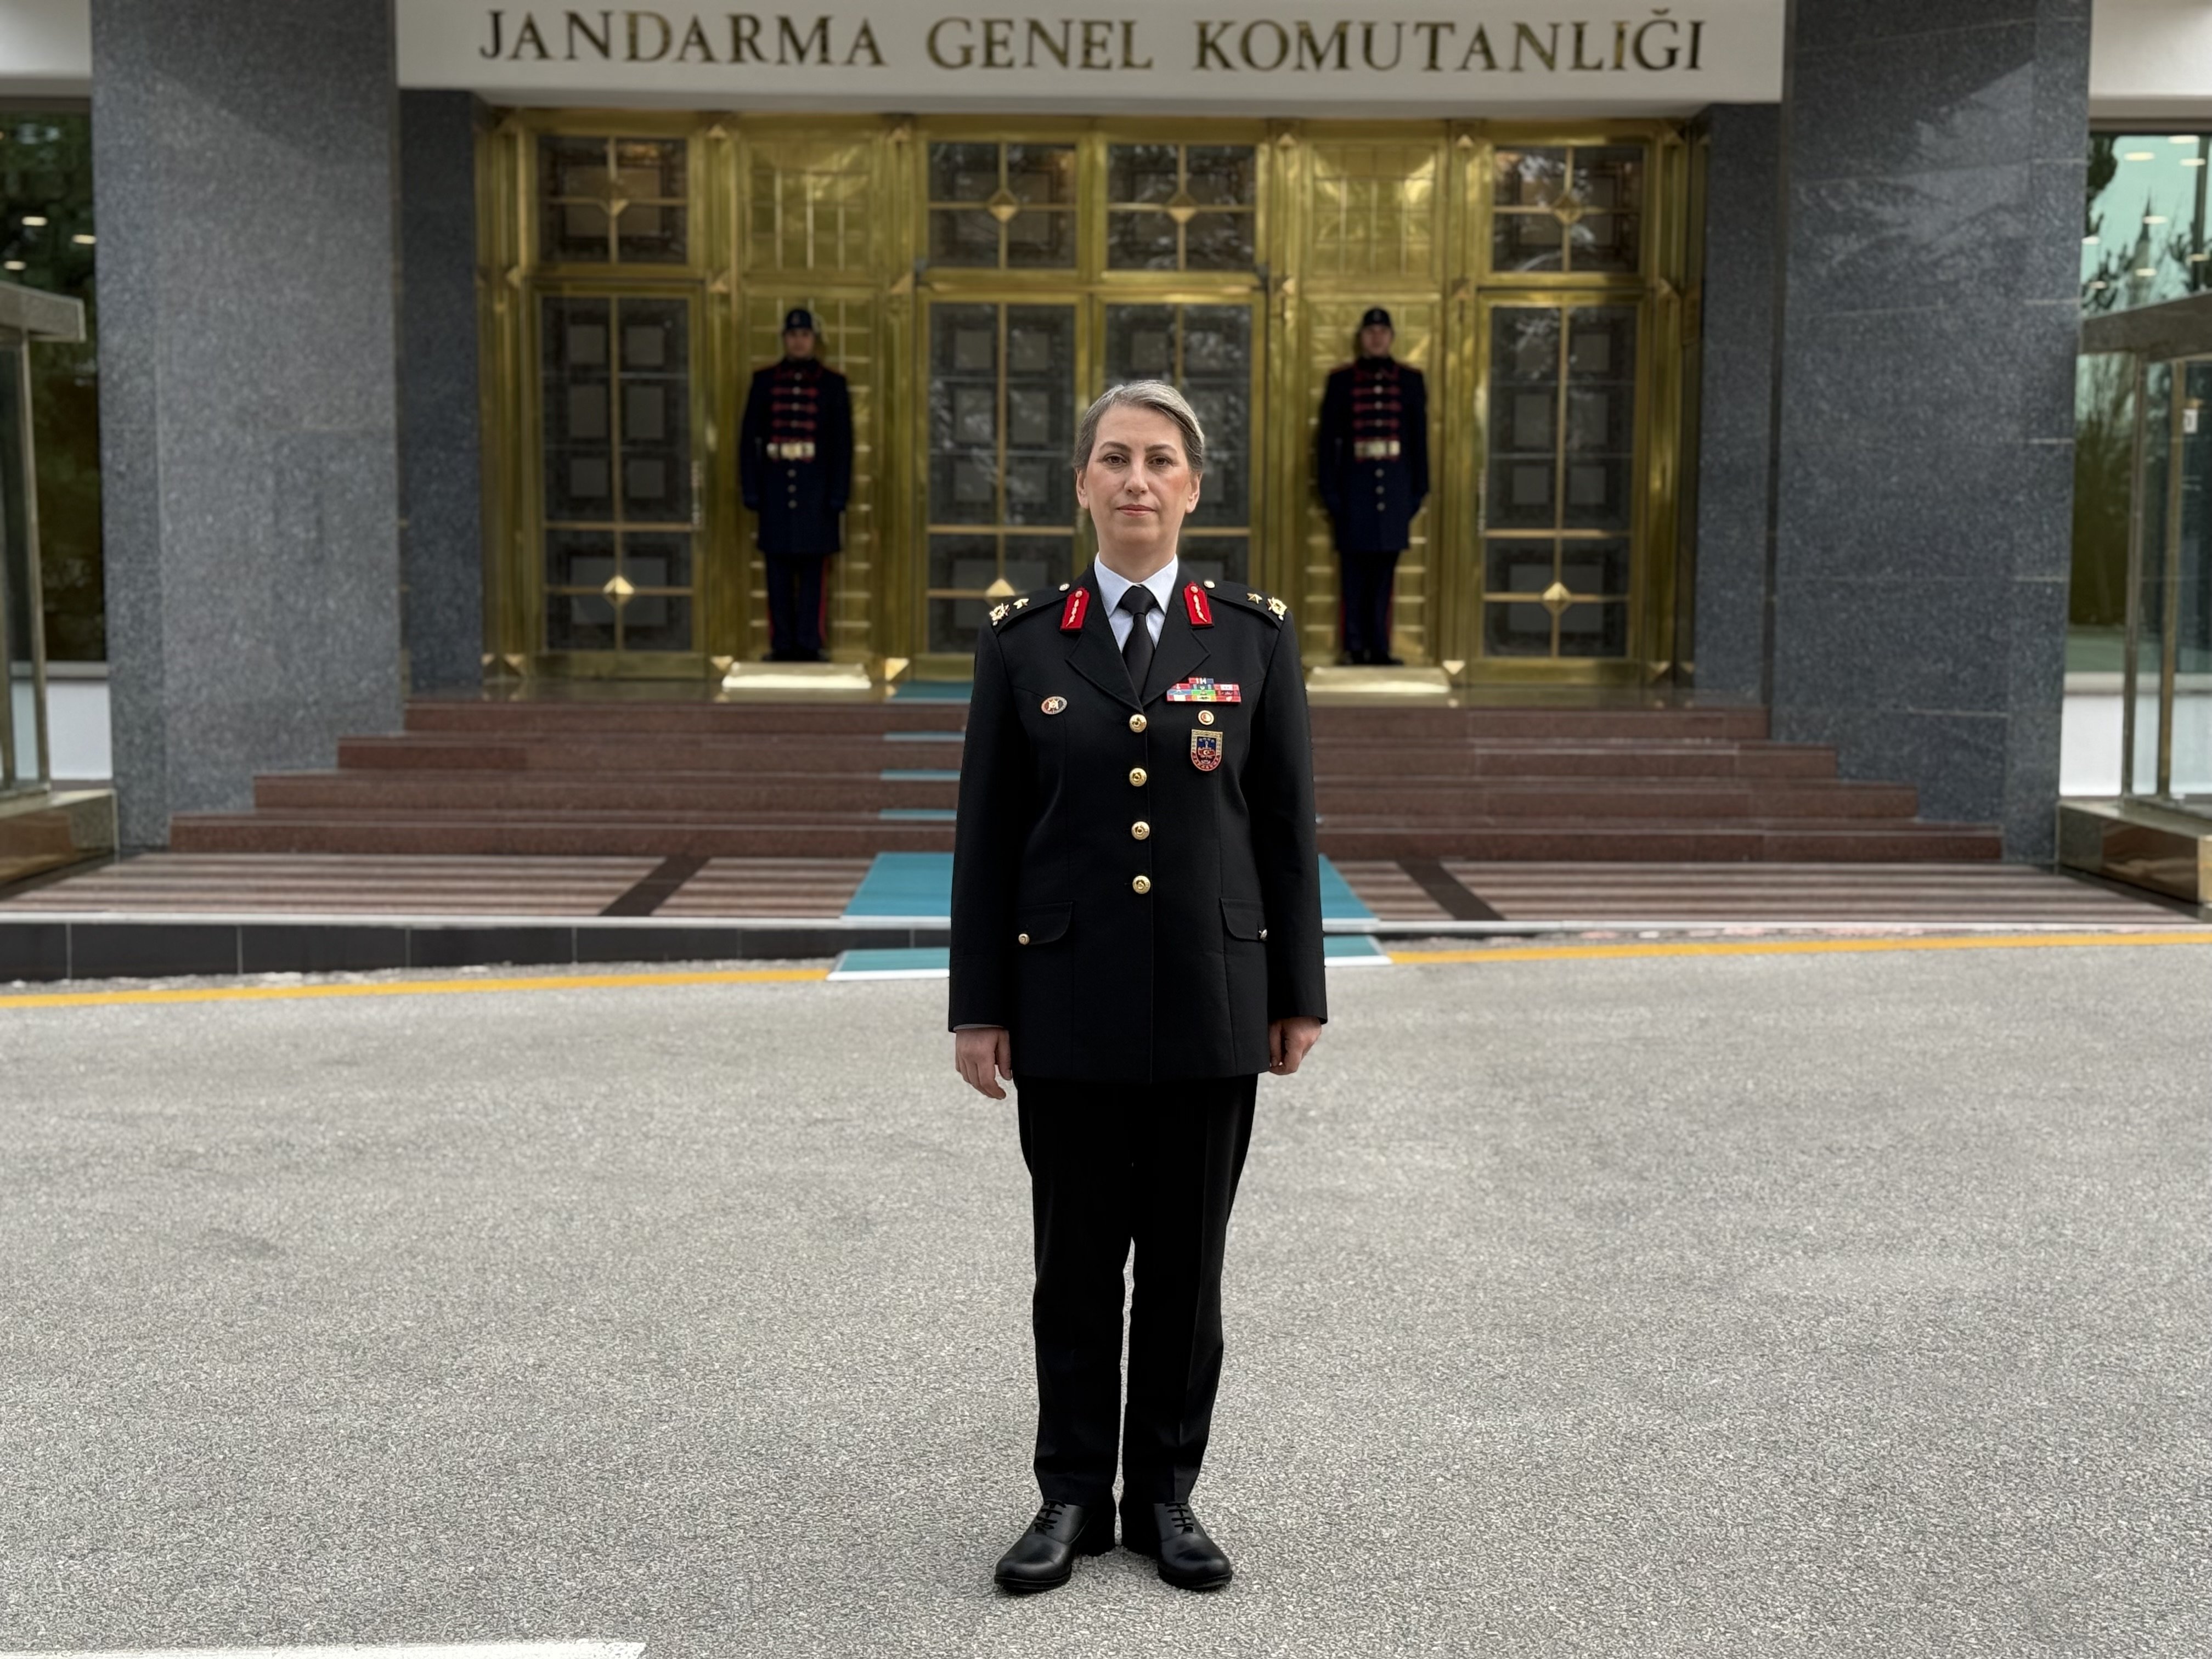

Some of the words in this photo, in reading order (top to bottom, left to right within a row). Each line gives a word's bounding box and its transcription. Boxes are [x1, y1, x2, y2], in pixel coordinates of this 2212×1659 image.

[479, 10, 886, 66] JANDARMA
[926, 17, 1153, 70] GENEL
[1194, 8, 1705, 72] KOMUTANLIĞI
